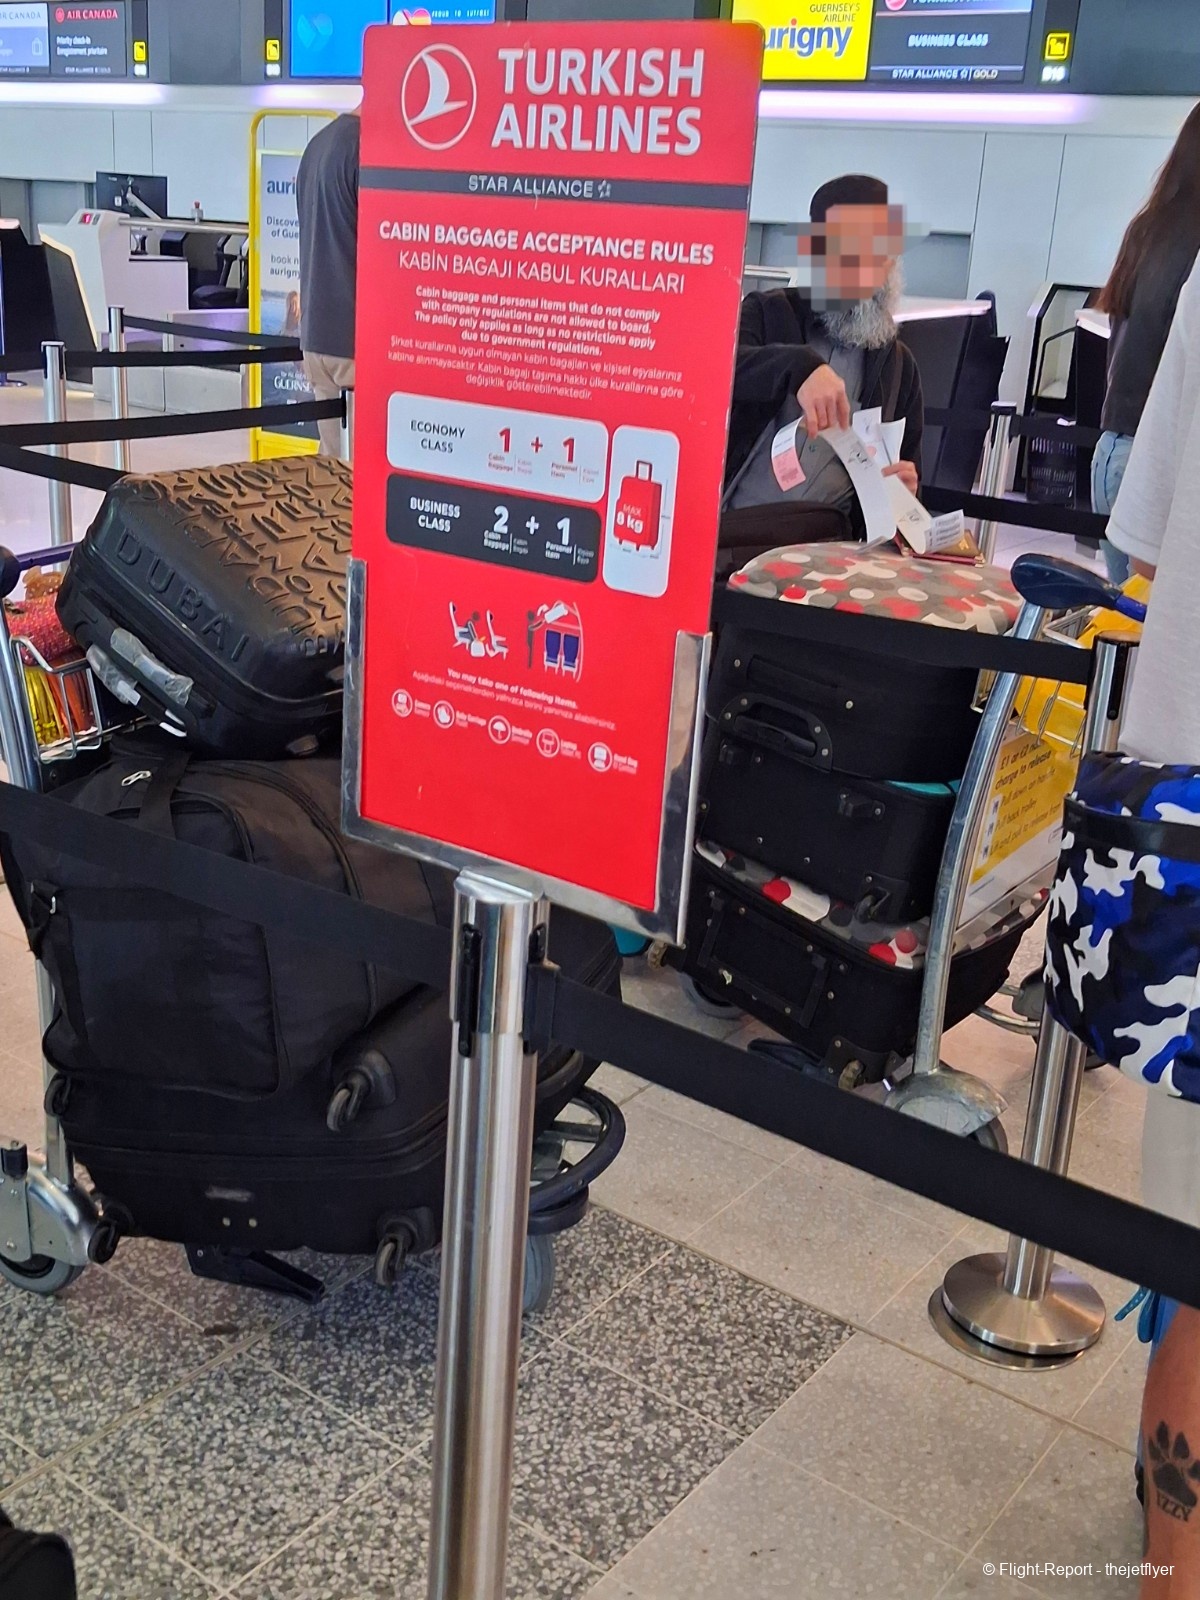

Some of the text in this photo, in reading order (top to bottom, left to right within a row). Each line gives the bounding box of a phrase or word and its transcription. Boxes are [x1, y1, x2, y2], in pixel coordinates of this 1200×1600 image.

[9, 11, 41, 20] CANADA
[67, 9, 118, 20] AIR CANADA
[809, 3, 860, 13] GUERNSEY'S
[824, 13, 856, 23] AIRLINE
[763, 18, 853, 57] urigny
[907, 33, 989, 47] BUSINESS CLASS
[498, 48, 705, 98] TURKISH
[892, 69, 998, 79] STAR ALLIANCE GOLD
[490, 103, 702, 156] AIRLINES
[267, 176, 297, 195] auri
[468, 174, 594, 198] STAR ALLIANCE
[266, 216, 299, 228] Discove
[271, 229, 281, 238] of
[379, 220, 715, 266] CABIN BAGGAGE ACCEPTANCE RULES
[271, 254, 292, 265] book
[452, 254, 513, 279] BAGAJI
[516, 260, 576, 286] KABUL
[580, 266, 686, 295] KURALLARI
[416, 285, 661, 323] Cabin baggage and personal items that do not comply
[421, 299, 440, 311] with
[441, 303, 481, 318] company
[482, 307, 532, 322] regulations
[534, 312, 548, 323] are
[551, 313, 567, 325] not
[569, 315, 605, 329] allowed
[607, 319, 619, 330] to
[415, 310, 657, 351] The policy only applies as long as no restrictions apply
[461, 329, 479, 341] due
[480, 331, 490, 343] to
[491, 334, 545, 350] government
[410, 420, 465, 439] ECONOMY
[421, 438, 454, 454] CLASS
[499, 427, 511, 453] 1
[563, 437, 575, 462] 1
[410, 496, 460, 519] BUSINESS
[622, 503, 642, 516] MAX
[418, 515, 451, 533] CLASS
[493, 505, 509, 534] 2
[557, 517, 570, 546] 1
[626, 514, 644, 534] kg
[116, 530, 250, 663] DUBAI
[448, 667, 461, 679] You
[461, 673, 477, 684] may
[478, 676, 494, 688] take
[509, 685, 518, 694] of
[520, 686, 554, 705] following
[995, 750, 1052, 790] charge to release
